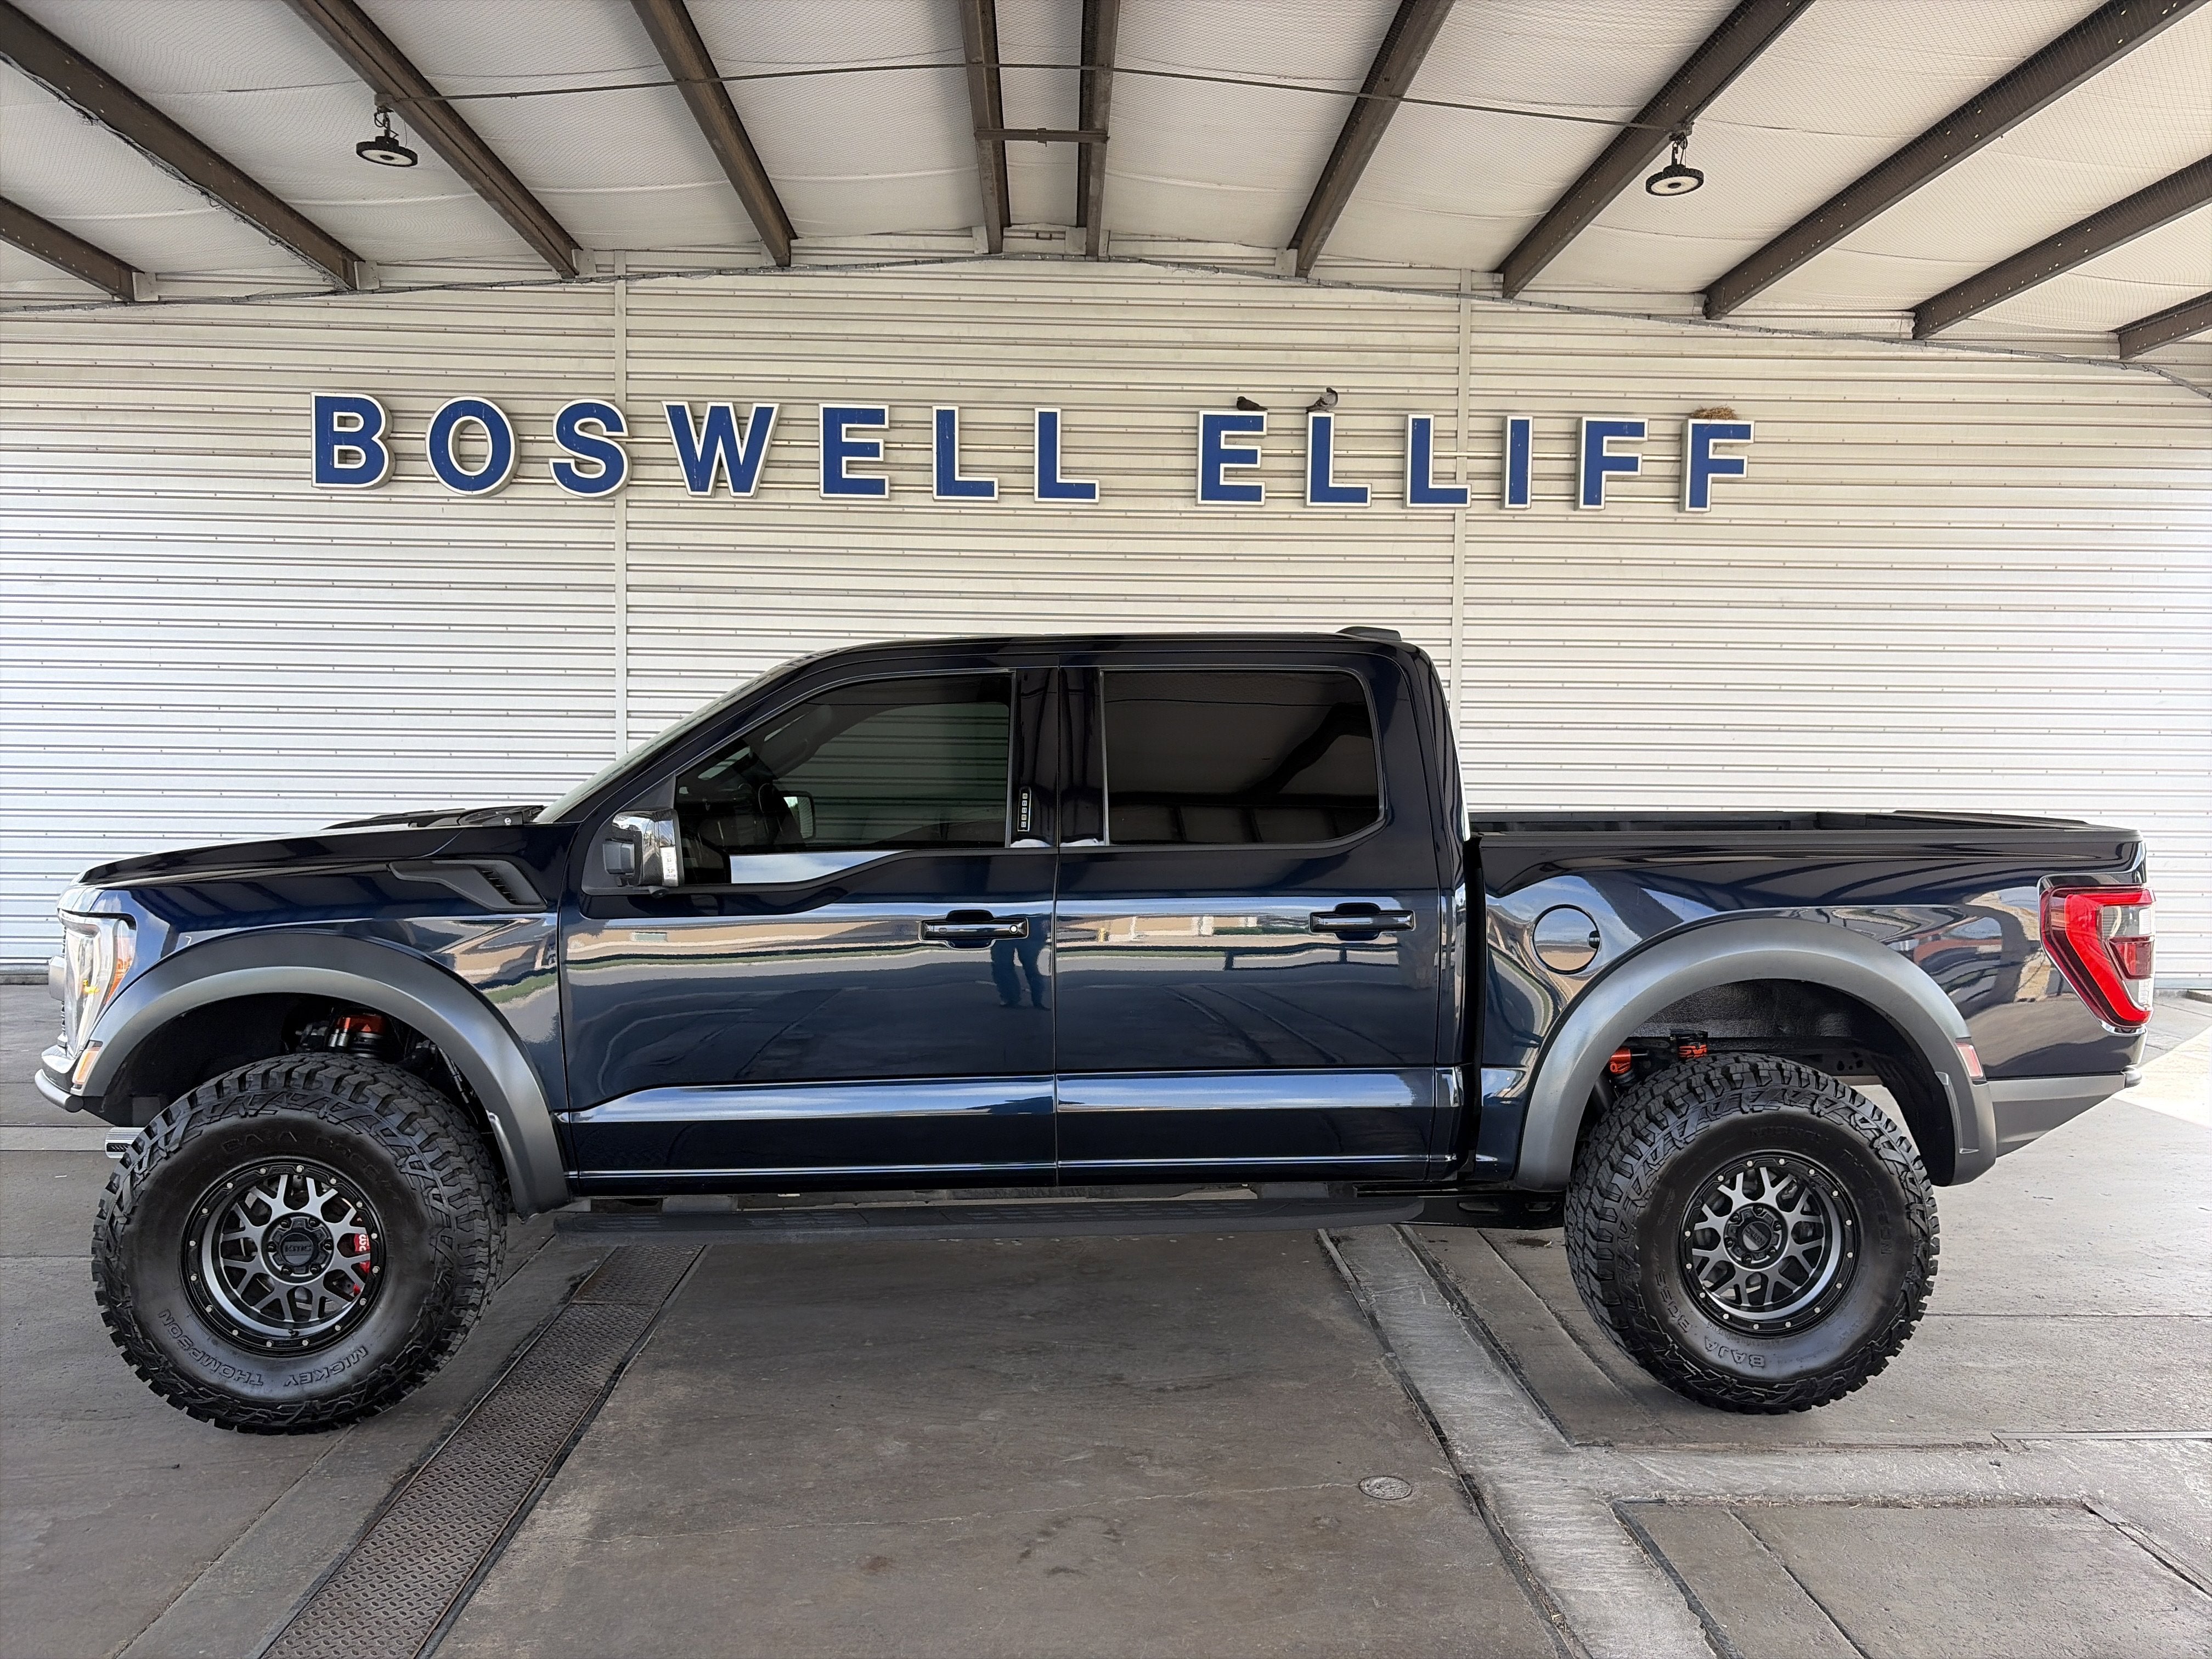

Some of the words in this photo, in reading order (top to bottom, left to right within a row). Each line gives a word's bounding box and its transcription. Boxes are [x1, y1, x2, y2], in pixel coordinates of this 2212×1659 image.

[311, 391, 1100, 503] BOSWELL
[1197, 410, 1754, 513] ELLIFF
[157, 1308, 264, 1388] THOMPSON
[283, 1345, 369, 1387] MICKEY
[1704, 1336, 1765, 1369] BAJA
